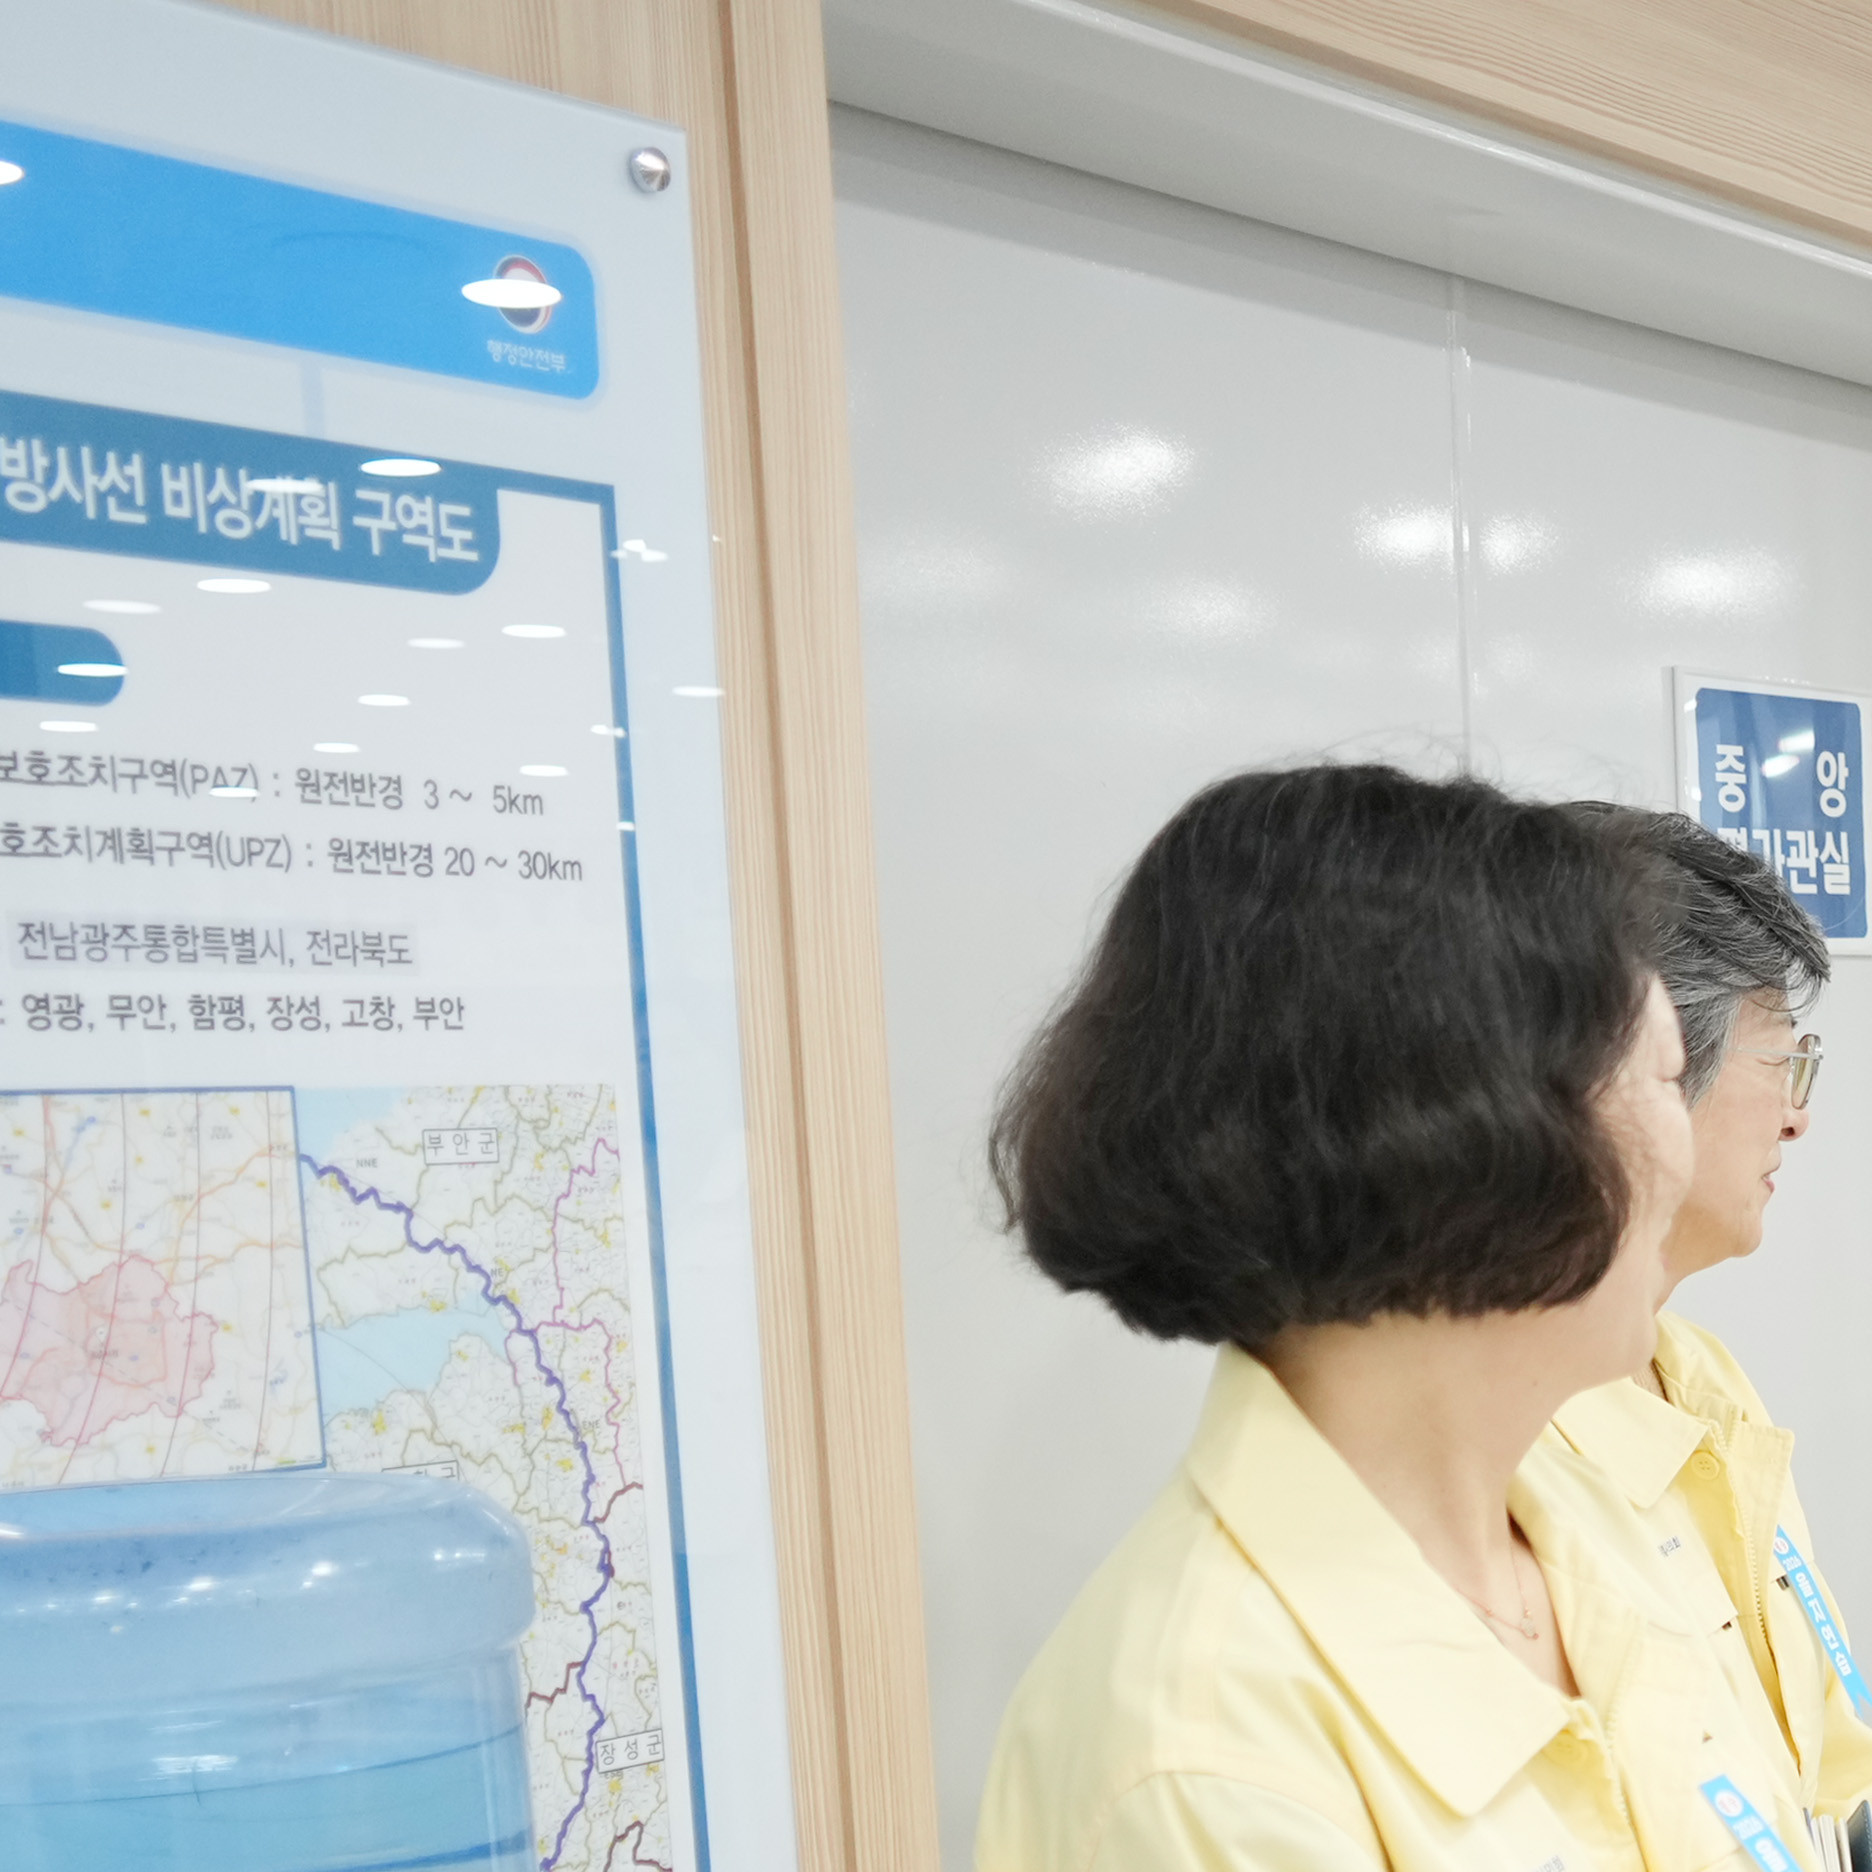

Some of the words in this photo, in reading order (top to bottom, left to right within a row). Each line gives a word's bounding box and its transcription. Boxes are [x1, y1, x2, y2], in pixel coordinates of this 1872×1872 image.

[487, 339, 566, 374] 행정안전부
[0, 436, 148, 525] 방사선
[161, 460, 341, 551] 비상계획
[352, 488, 480, 563] 구역도
[295, 767, 404, 810] 원전반경
[423, 779, 440, 810] 3
[492, 785, 545, 816] 5km
[327, 837, 434, 878] 원전반경
[443, 846, 475, 877] 20
[517, 850, 583, 882] 30km
[17, 920, 295, 967] 전남광주통합특별시,
[305, 929, 414, 968] 전라북도
[21, 993, 94, 1034] 영광,
[106, 994, 177, 1034] 무안,
[187, 994, 256, 1034] 함평,
[265, 995, 331, 1034] 장성,
[341, 996, 403, 1034] 고창,
[412, 997, 464, 1032] 부안
[356, 1157, 378, 1169] NNE
